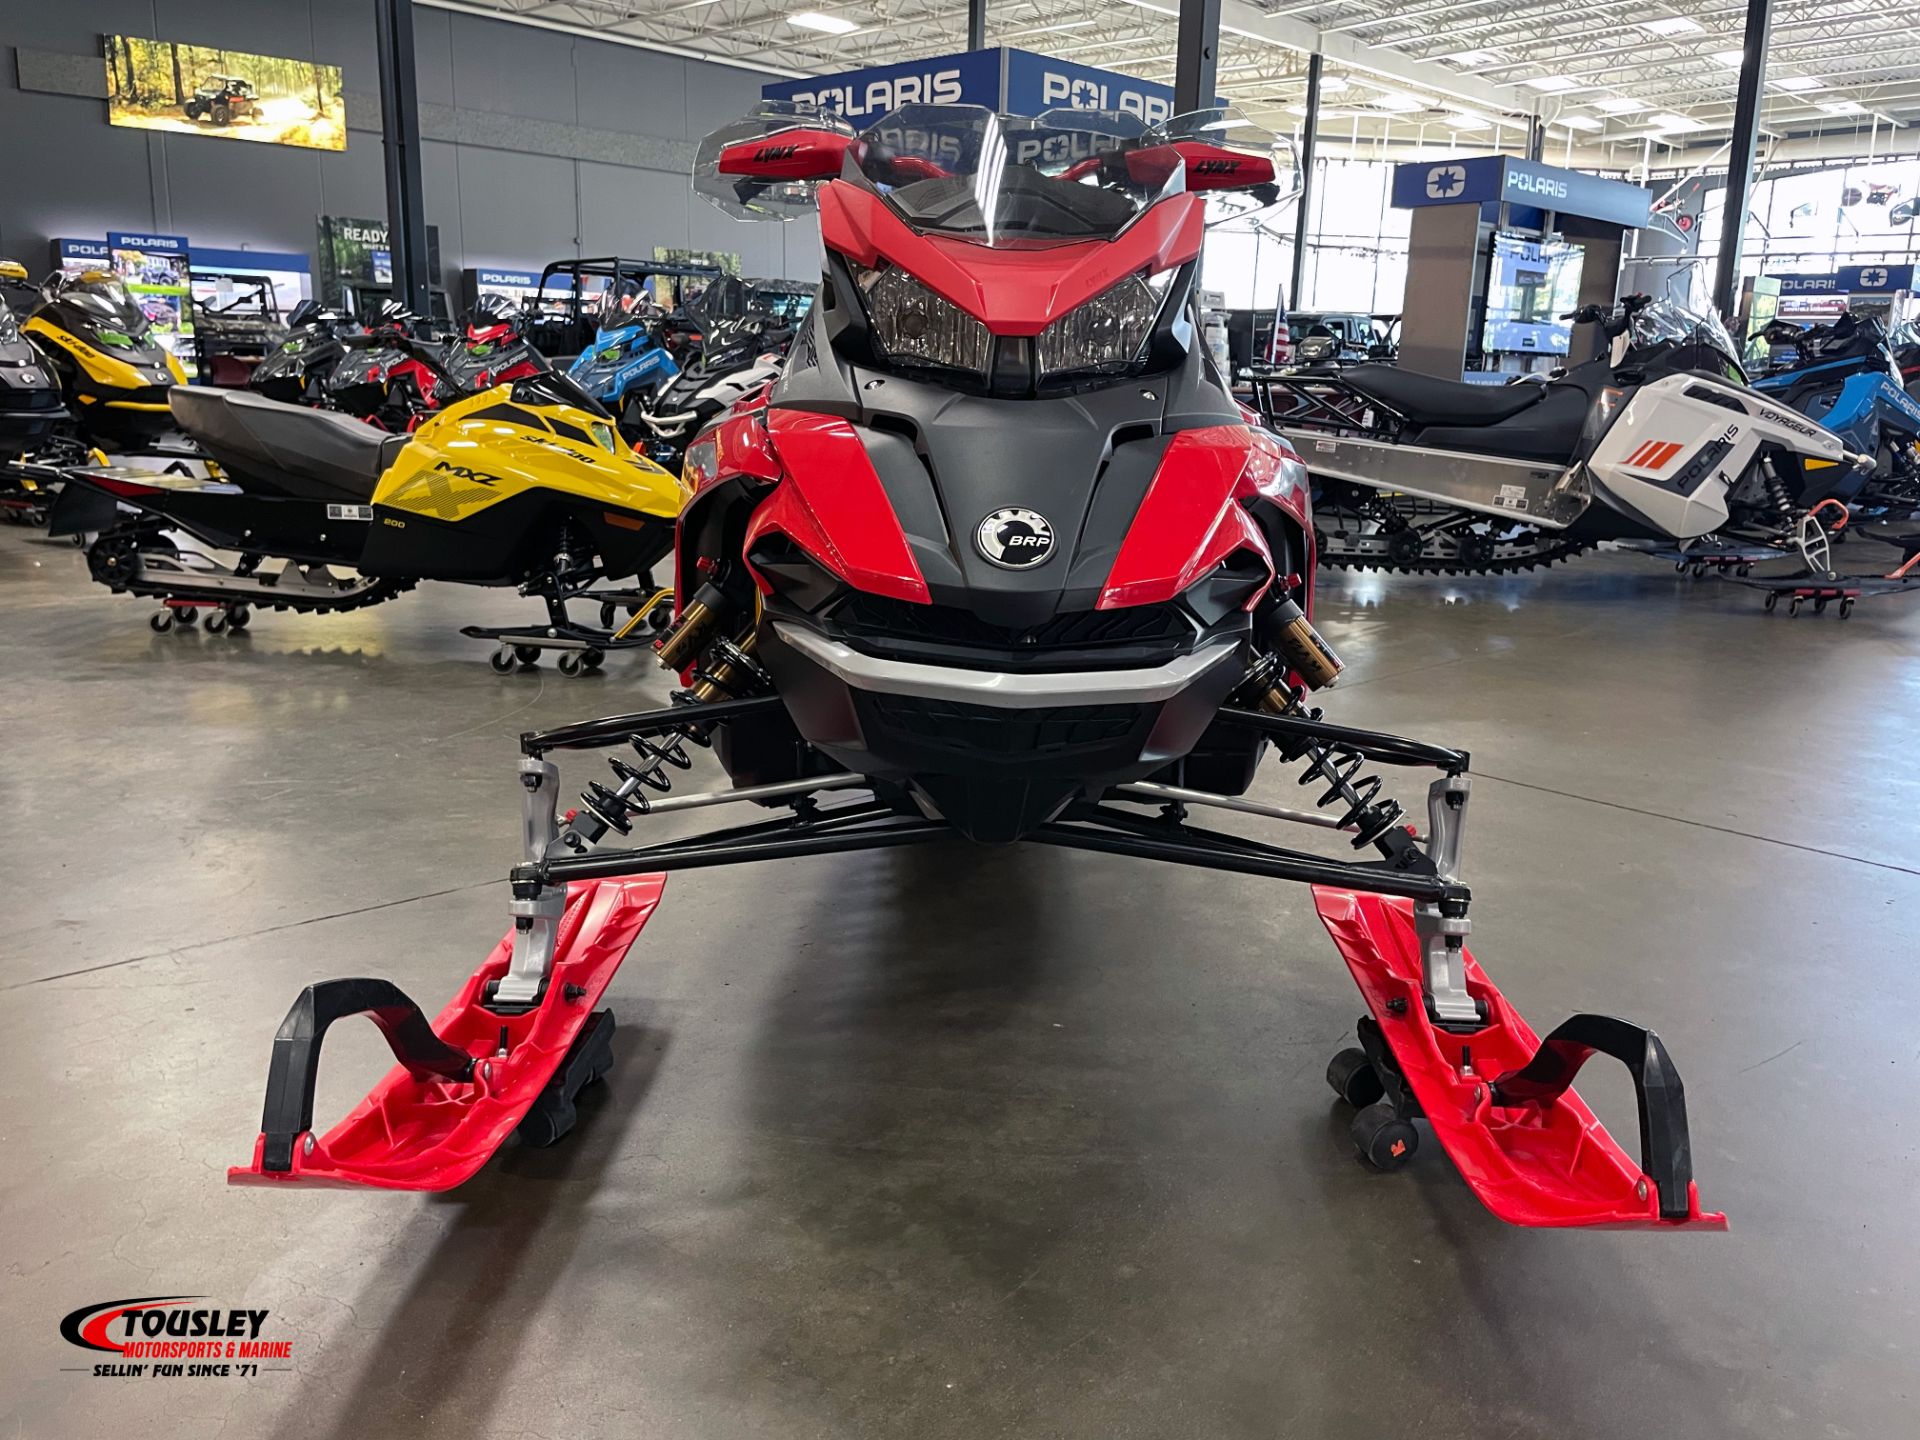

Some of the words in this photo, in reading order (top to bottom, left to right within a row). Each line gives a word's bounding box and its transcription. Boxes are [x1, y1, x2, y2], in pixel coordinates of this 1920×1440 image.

[792, 69, 962, 117] POLARIS
[1043, 72, 1175, 126] POLARI
[753, 144, 798, 162] LYNX
[1194, 160, 1241, 175] LYNX
[1507, 170, 1568, 198] POLARIS
[121, 237, 179, 248] POLARIS
[343, 227, 389, 243] READY
[68, 244, 108, 255] POLA
[482, 273, 531, 285] POLARIS
[1782, 279, 1836, 290] OLARI
[385, 353, 410, 369] POLA
[494, 350, 529, 375] POLARIS
[622, 355, 660, 380] POLARIS
[1759, 407, 1817, 438] VOYAGEUR
[1676, 423, 1739, 490] POLARIS
[434, 461, 503, 487] MXZ
[383, 518, 405, 529] 200
[1008, 535, 1050, 547] BRP
